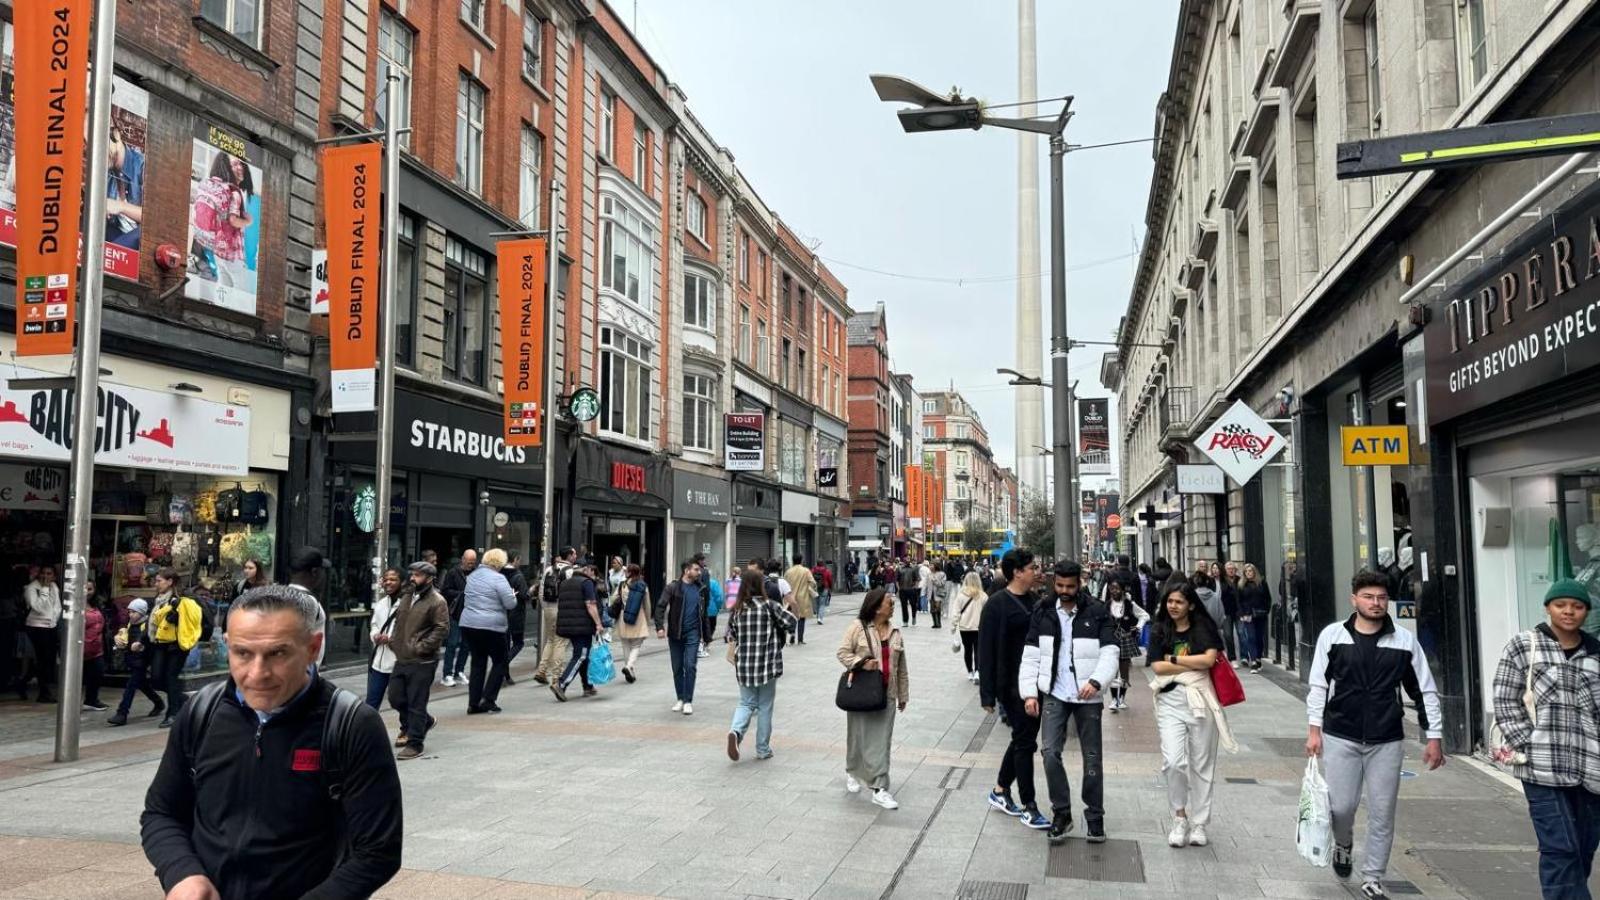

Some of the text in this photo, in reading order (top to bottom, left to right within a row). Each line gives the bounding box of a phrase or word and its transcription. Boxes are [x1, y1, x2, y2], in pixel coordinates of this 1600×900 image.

[51, 8, 70, 71] 2024
[47, 78, 67, 155] FINAL
[217, 131, 233, 143] you
[234, 140, 245, 150] go
[353, 163, 366, 209] 2024
[351, 215, 365, 270] FINAL
[522, 255, 533, 290] 2024
[520, 296, 532, 337] FINAL
[1449, 300, 1600, 393] GIFTS BEYOND EXPEC
[410, 419, 526, 464] STARBUCKS
[1207, 432, 1275, 457] RACY
[1351, 437, 1401, 454] ATM
[24, 466, 61, 491] BAG CITY
[613, 462, 647, 492] DIESEL
